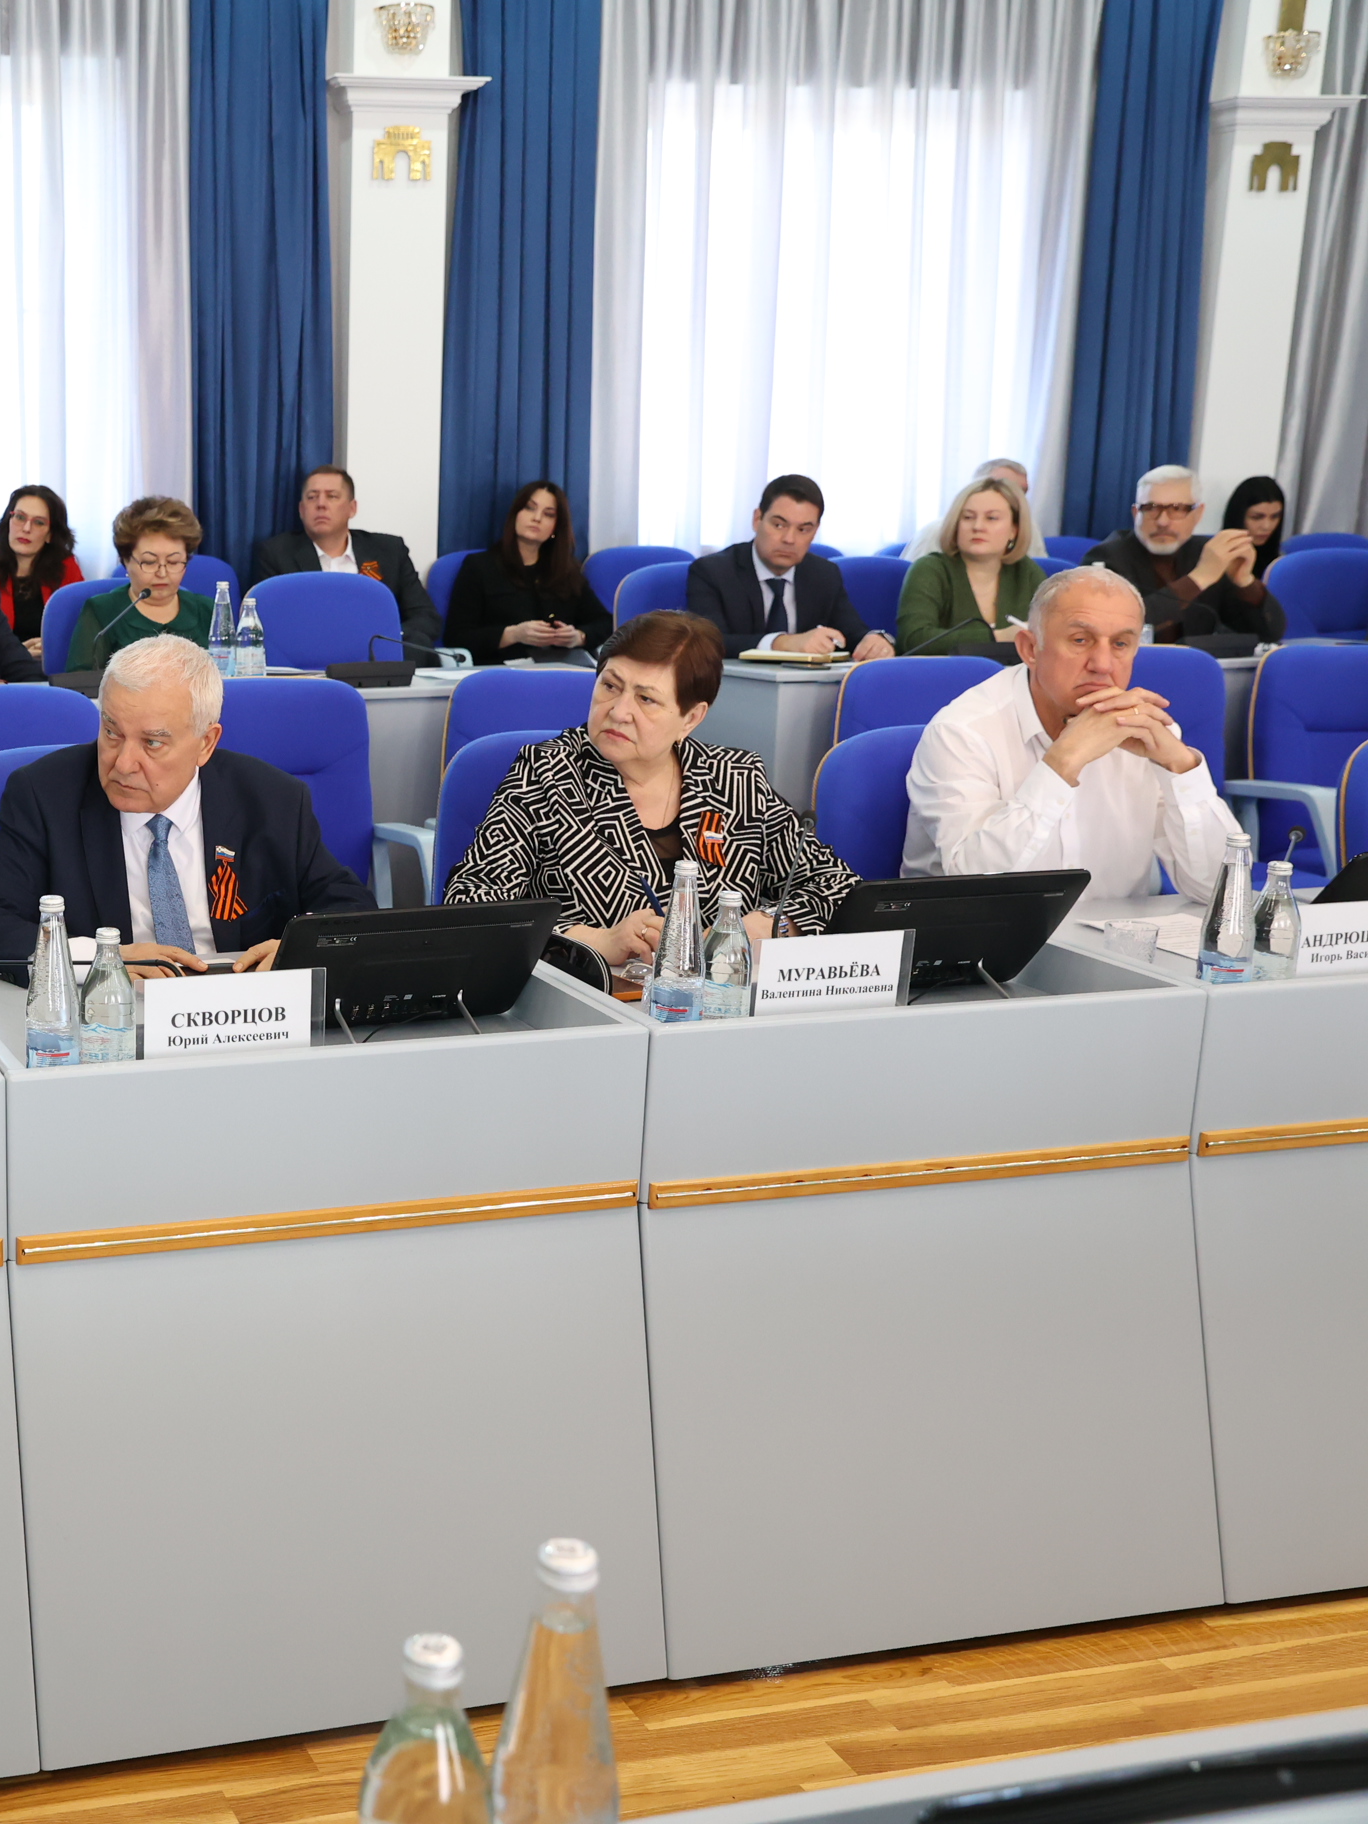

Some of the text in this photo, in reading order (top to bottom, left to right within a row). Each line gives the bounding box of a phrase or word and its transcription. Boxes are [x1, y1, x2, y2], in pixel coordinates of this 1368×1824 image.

[1311, 953, 1343, 964] Игорь
[777, 961, 881, 982] МУРАВЬЁВА
[761, 983, 894, 1000] Валентина Николаевна
[171, 1006, 287, 1029] СКВОРЦОВ
[167, 1031, 289, 1049] Юрий Алексеевич
